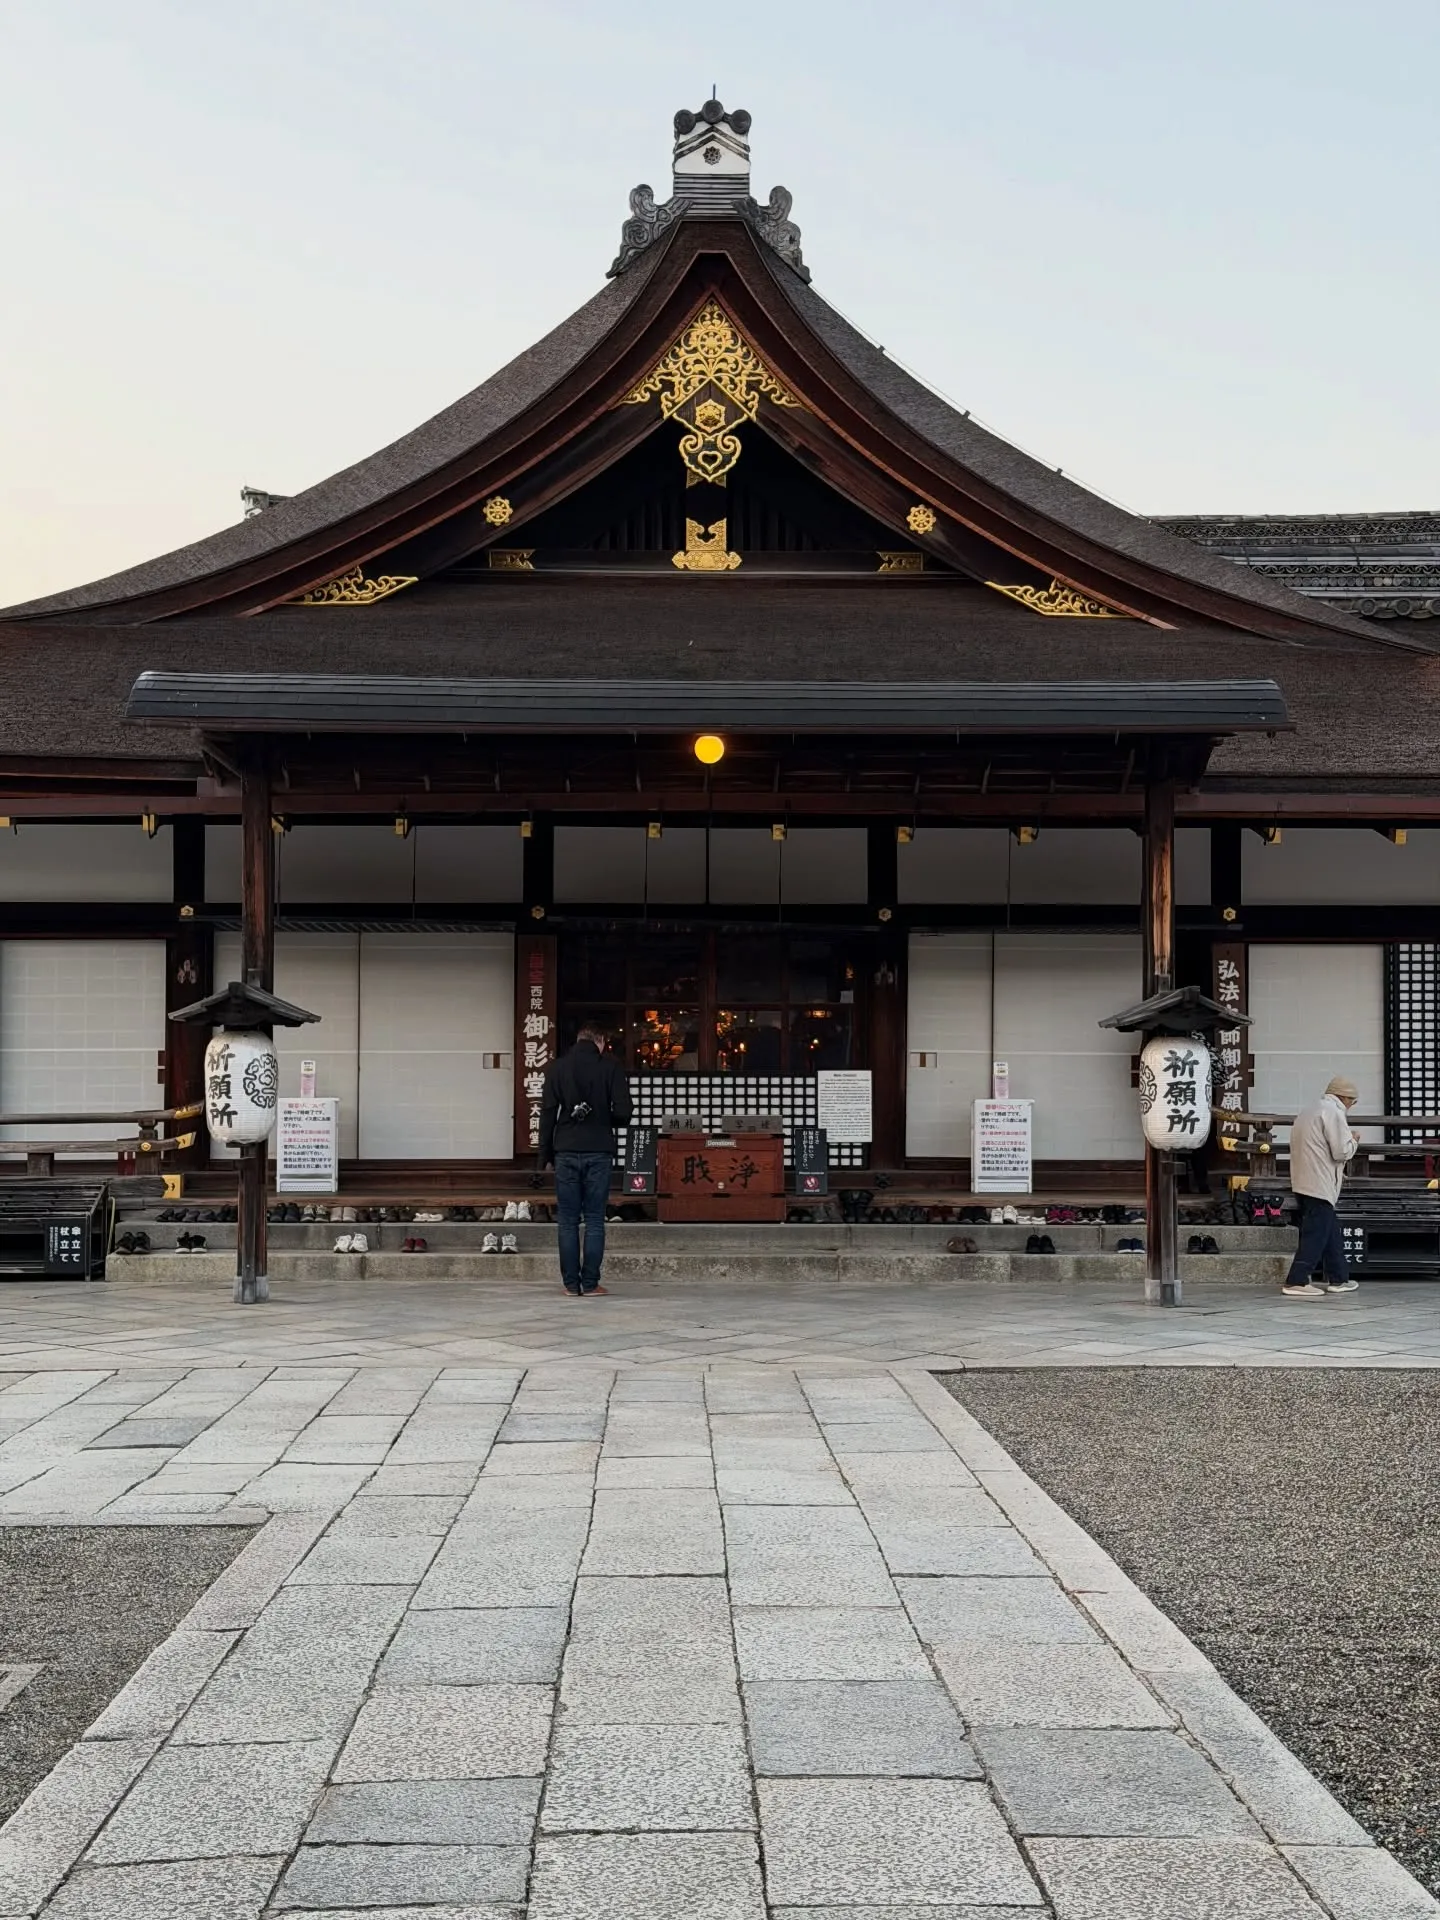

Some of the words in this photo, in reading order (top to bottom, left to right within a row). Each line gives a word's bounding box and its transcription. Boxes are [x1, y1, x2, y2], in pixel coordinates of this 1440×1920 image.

[530, 986, 544, 1010] 西院
[523, 1013, 549, 1098] 御影堂
[208, 1044, 238, 1128] 祈願所
[1163, 1050, 1200, 1135] 祈願所
[669, 1118, 696, 1130] 納札
[60, 1226, 70, 1262] 杖立て
[71, 1226, 81, 1262] 傘立て
[1343, 1227, 1352, 1263] 杖立て
[1354, 1227, 1364, 1263] 傘立て
